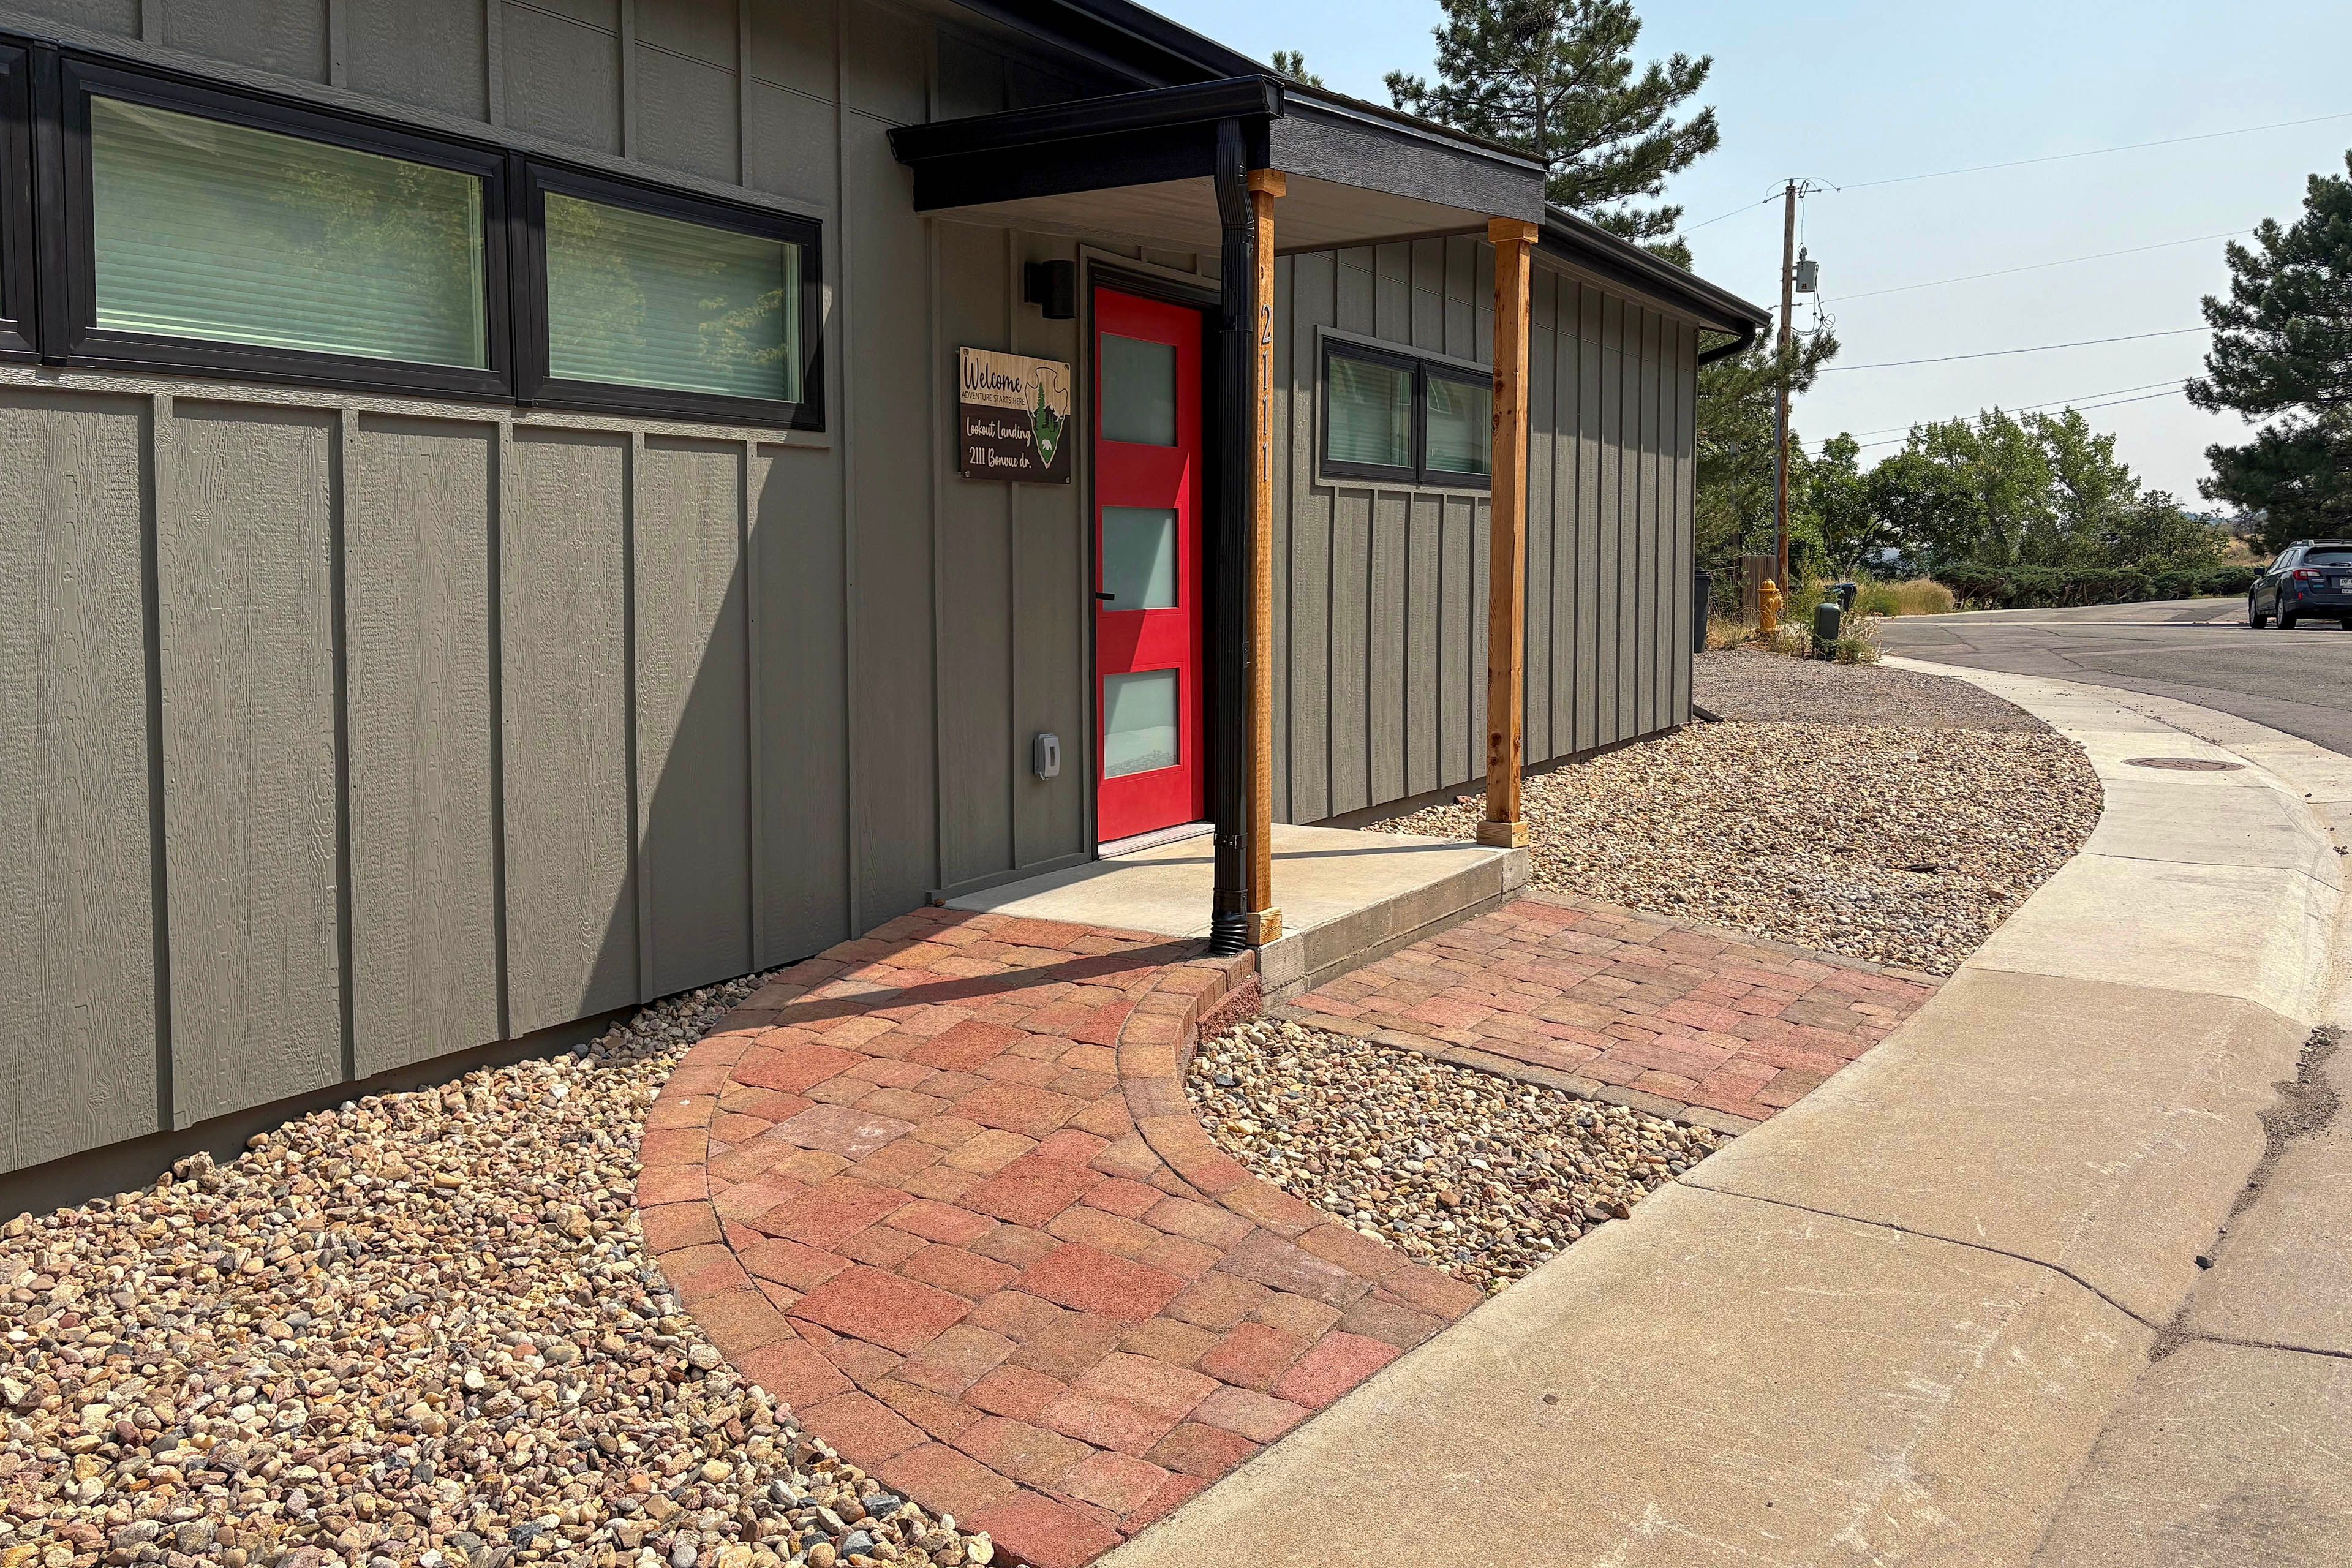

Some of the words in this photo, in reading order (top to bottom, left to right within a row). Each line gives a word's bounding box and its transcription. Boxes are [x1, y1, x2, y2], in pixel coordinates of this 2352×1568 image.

[964, 356, 1022, 393] Welcome
[961, 391, 992, 402] ADVENTURE
[993, 394, 1012, 404] STARTS
[1012, 397, 1025, 405] HERE
[1261, 303, 1272, 481] 2111
[967, 417, 995, 437] Lookout
[997, 420, 1031, 447] Landing
[969, 446, 985, 465] 2111
[988, 447, 1018, 467] Bonvue
[1019, 452, 1031, 469] dr.
